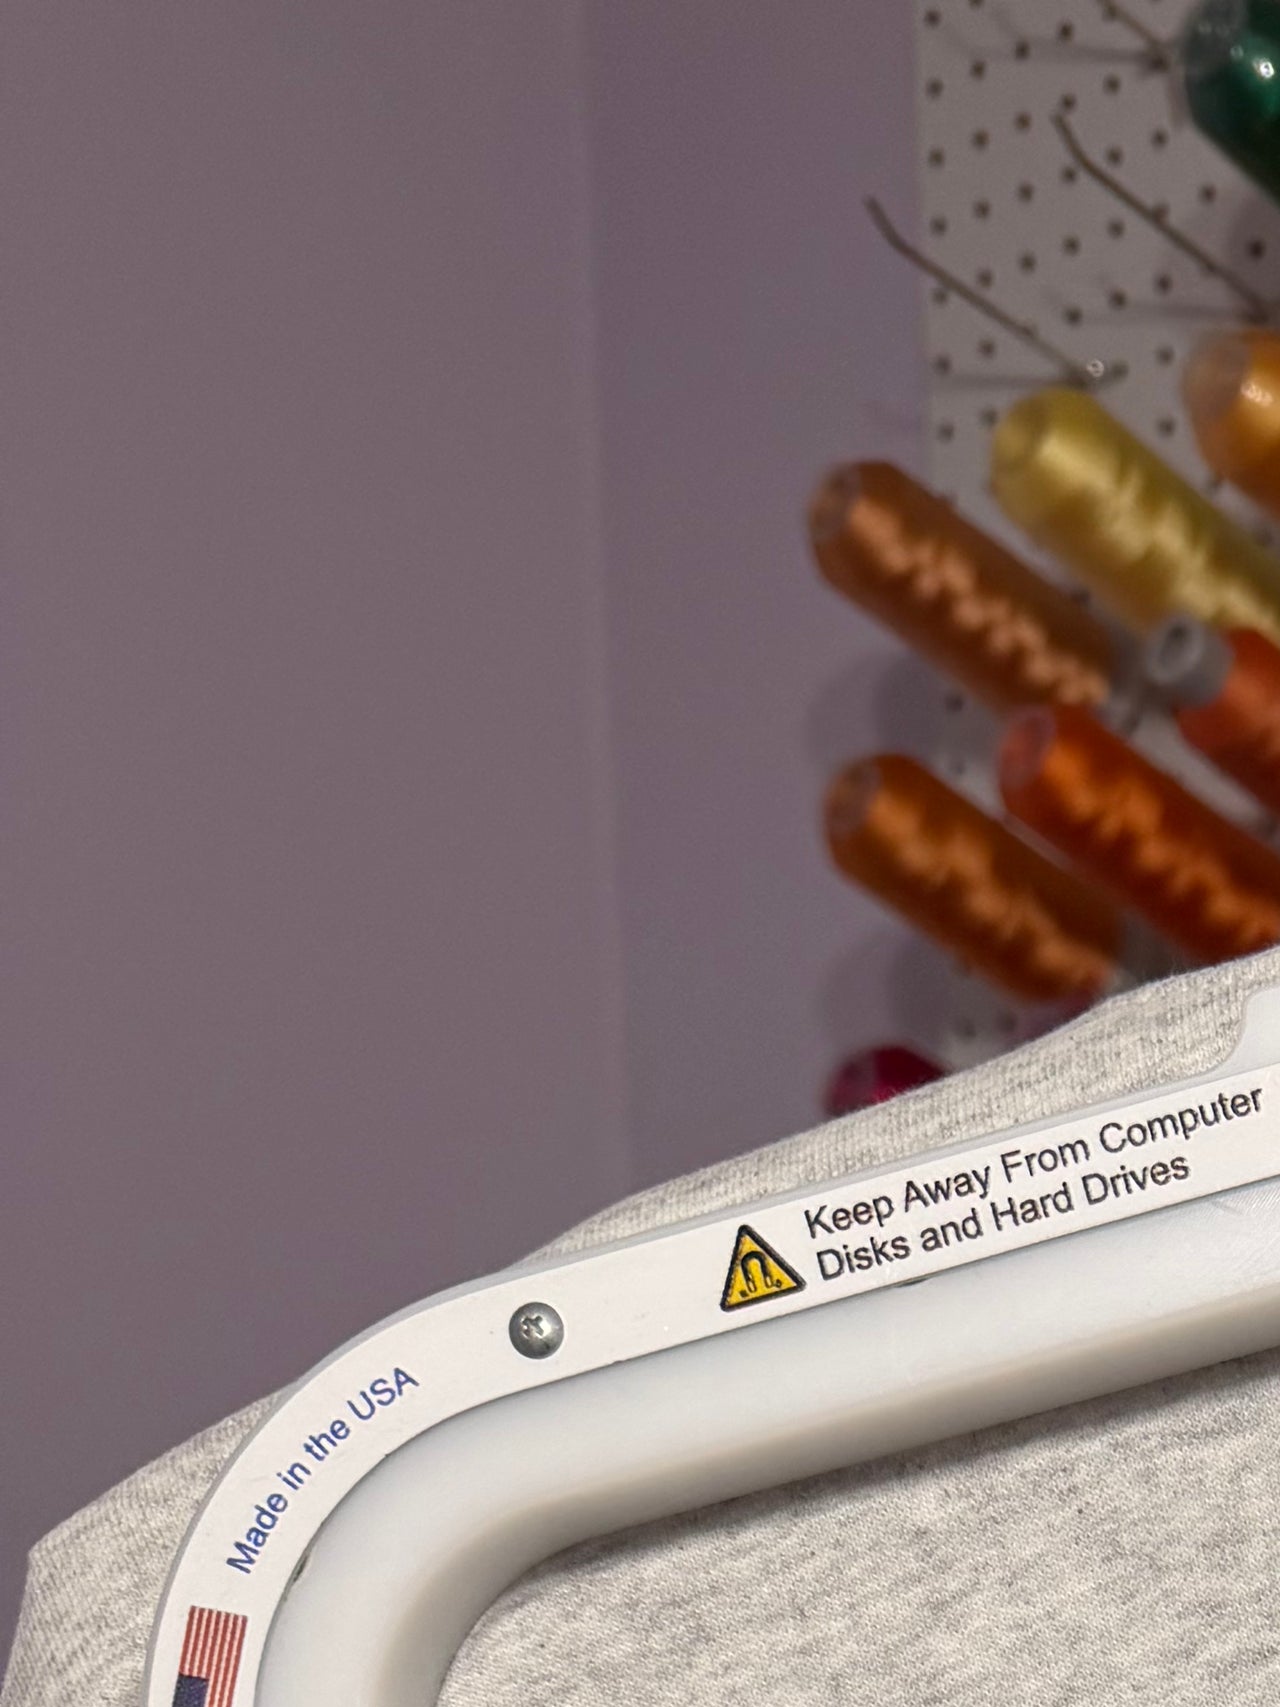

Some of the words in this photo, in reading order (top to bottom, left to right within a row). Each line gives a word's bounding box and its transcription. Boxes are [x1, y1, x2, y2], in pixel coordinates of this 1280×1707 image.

[803, 1195, 895, 1240] Keep
[904, 1165, 991, 1213] Away
[1000, 1139, 1091, 1184] From
[1099, 1088, 1262, 1154] Computer
[816, 1235, 911, 1281] Disks
[919, 1207, 984, 1252] and
[989, 1181, 1075, 1232] Hard
[1081, 1156, 1190, 1206] Drives
[225, 1493, 288, 1574] Made
[276, 1462, 312, 1491] in
[303, 1419, 351, 1462] the
[346, 1367, 420, 1421] USA
